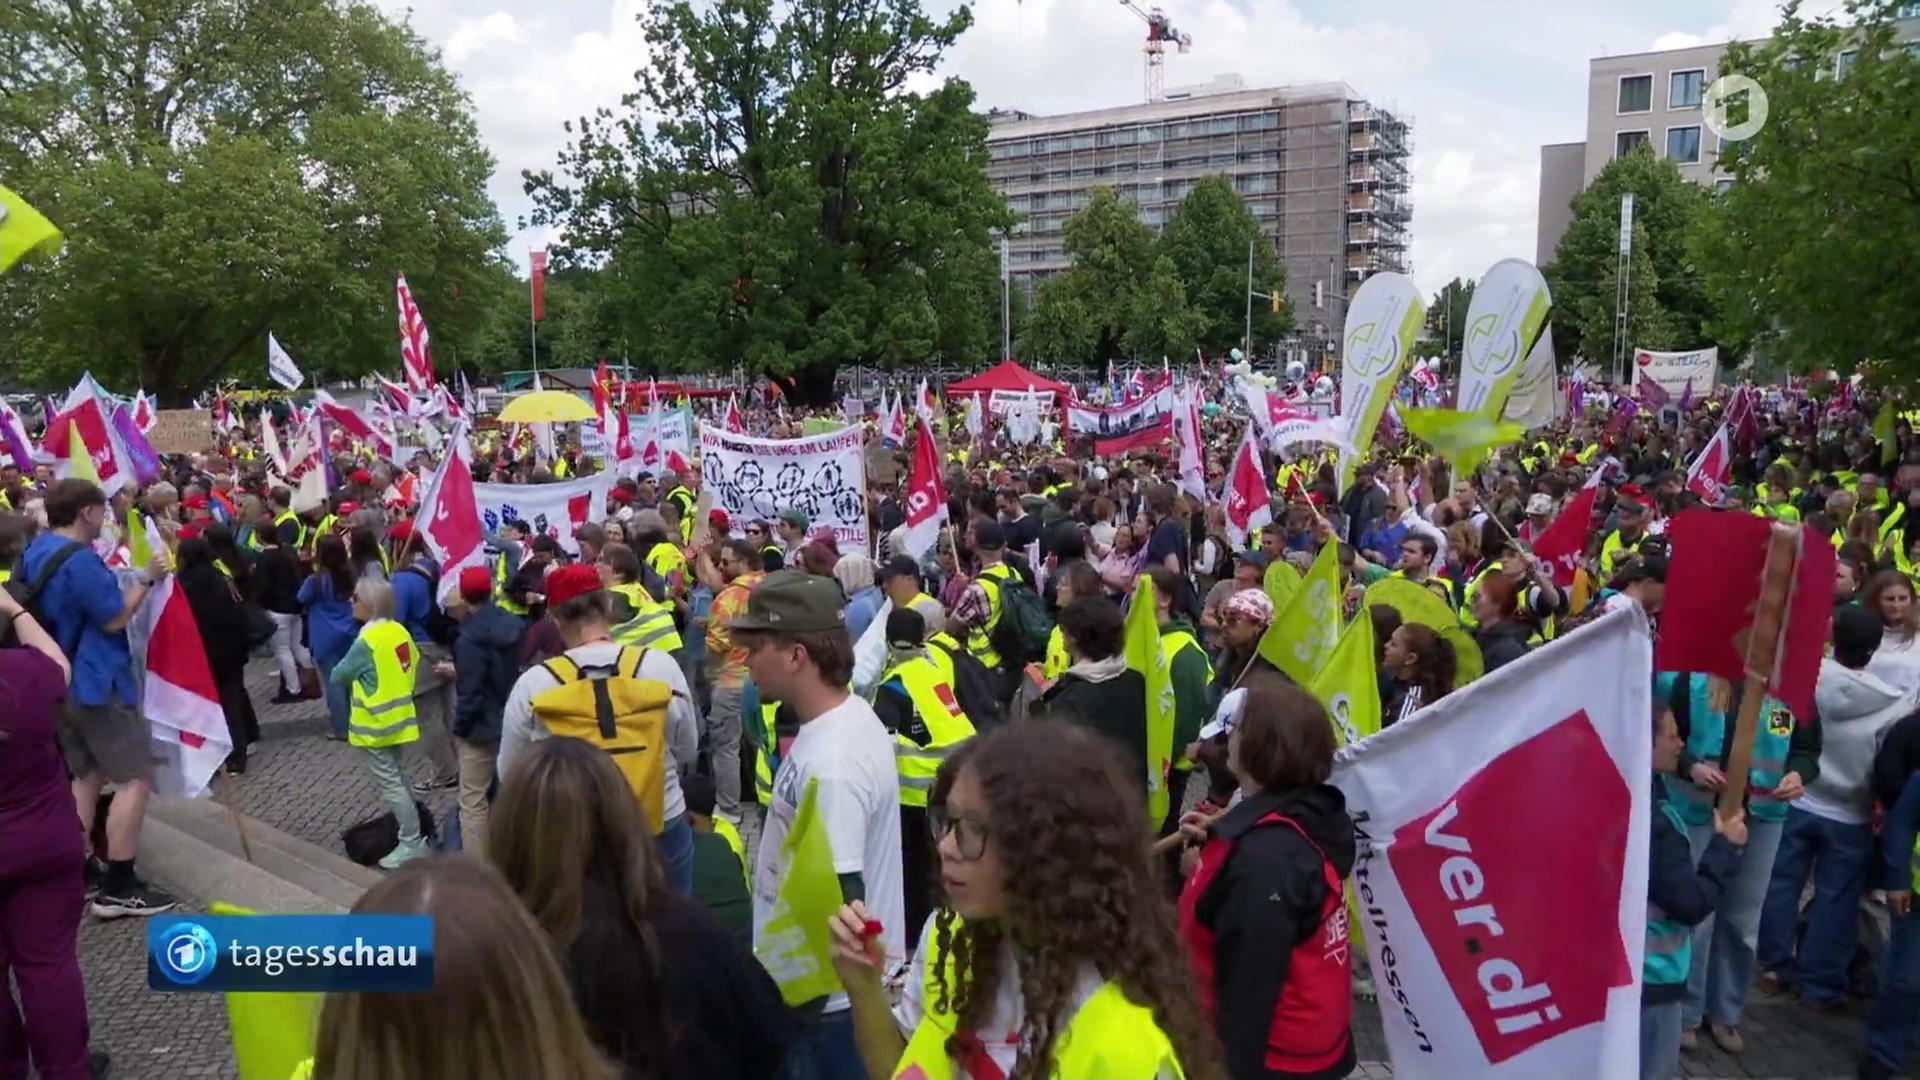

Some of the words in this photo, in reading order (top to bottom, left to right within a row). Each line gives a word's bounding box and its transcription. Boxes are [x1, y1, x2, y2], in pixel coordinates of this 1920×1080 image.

[800, 443, 817, 455] AM
[819, 434, 860, 453] LAUFEN
[1351, 809, 1434, 1054] Mittelhessen
[1424, 799, 1562, 1035] ver.di
